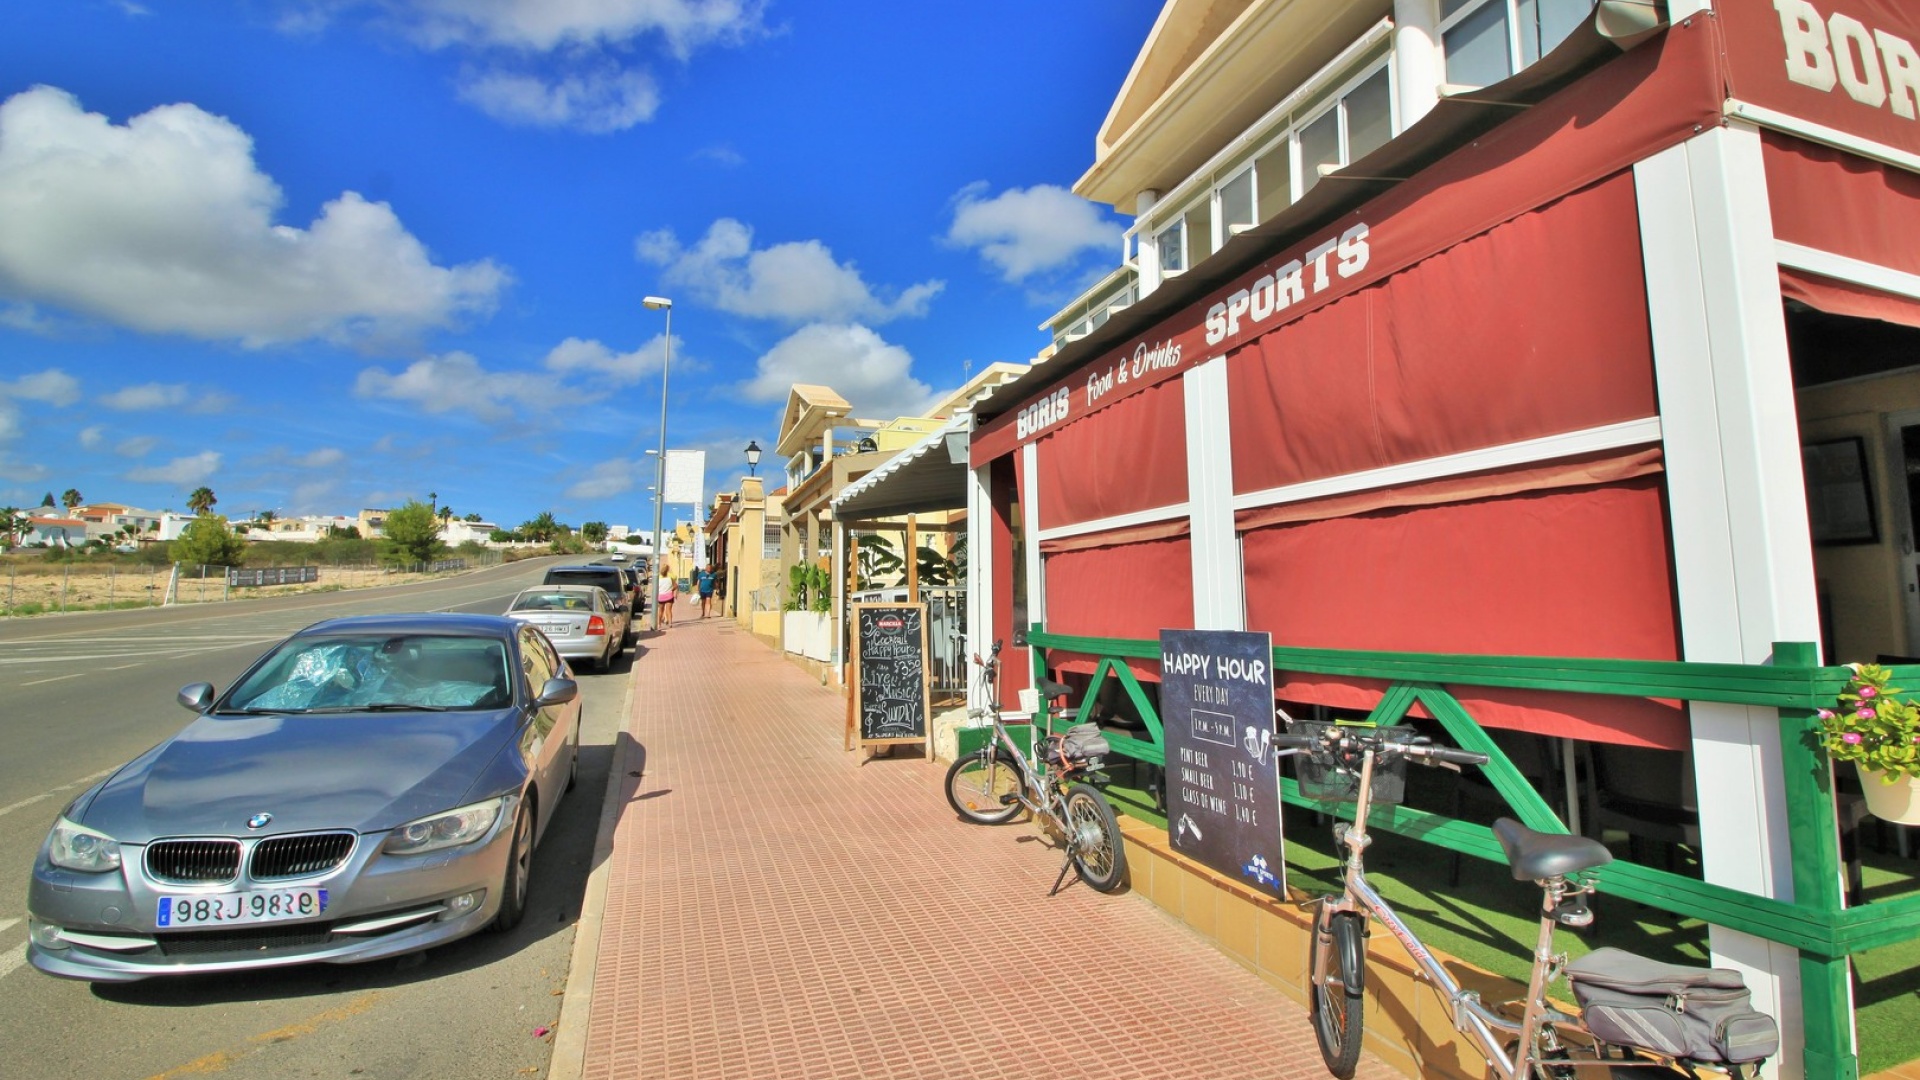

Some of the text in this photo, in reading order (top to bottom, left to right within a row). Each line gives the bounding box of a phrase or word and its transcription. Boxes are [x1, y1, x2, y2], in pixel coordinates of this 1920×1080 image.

[1017, 222, 1370, 440] BORIS Food & Drinks SPORTS
[1163, 652, 1266, 686] HAPPY HOUR
[1194, 684, 1229, 706] EVERY DAY
